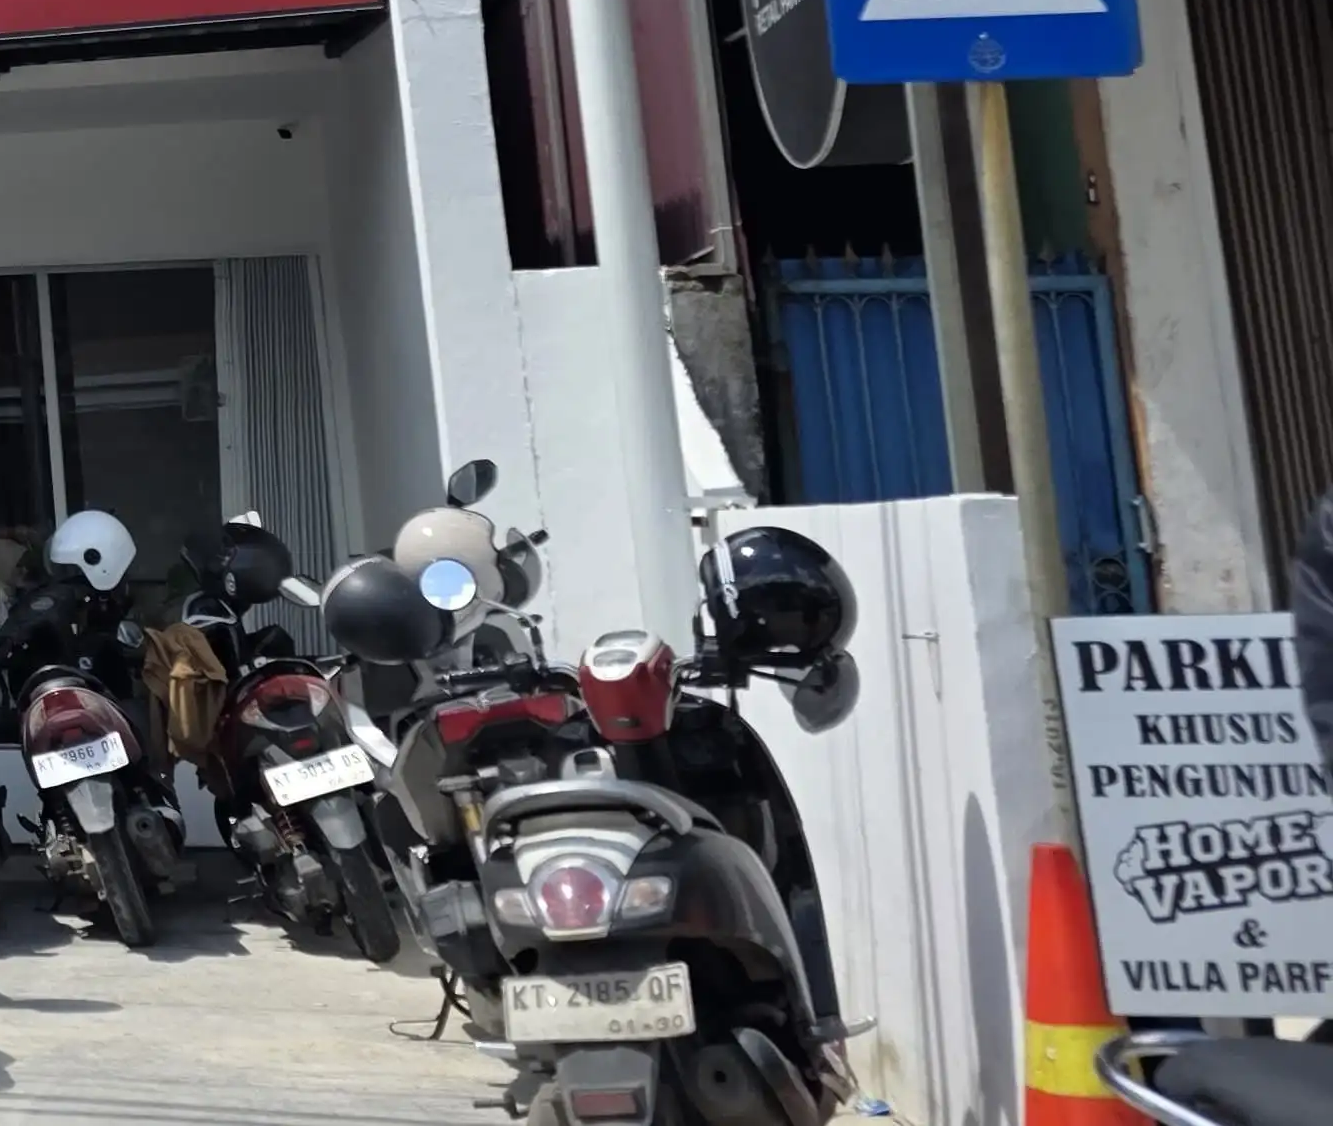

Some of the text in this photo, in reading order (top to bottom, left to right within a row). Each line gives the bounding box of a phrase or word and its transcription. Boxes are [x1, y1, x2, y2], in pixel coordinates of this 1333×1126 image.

[1071, 636, 1302, 693] PARKI
[1134, 712, 1301, 746] KHUSUS
[1136, 812, 1318, 874] HOME
[1234, 919, 1269, 949] &
[512, 973, 683, 1011] KT 2185 QF
[1120, 960, 1229, 993] VILLA
